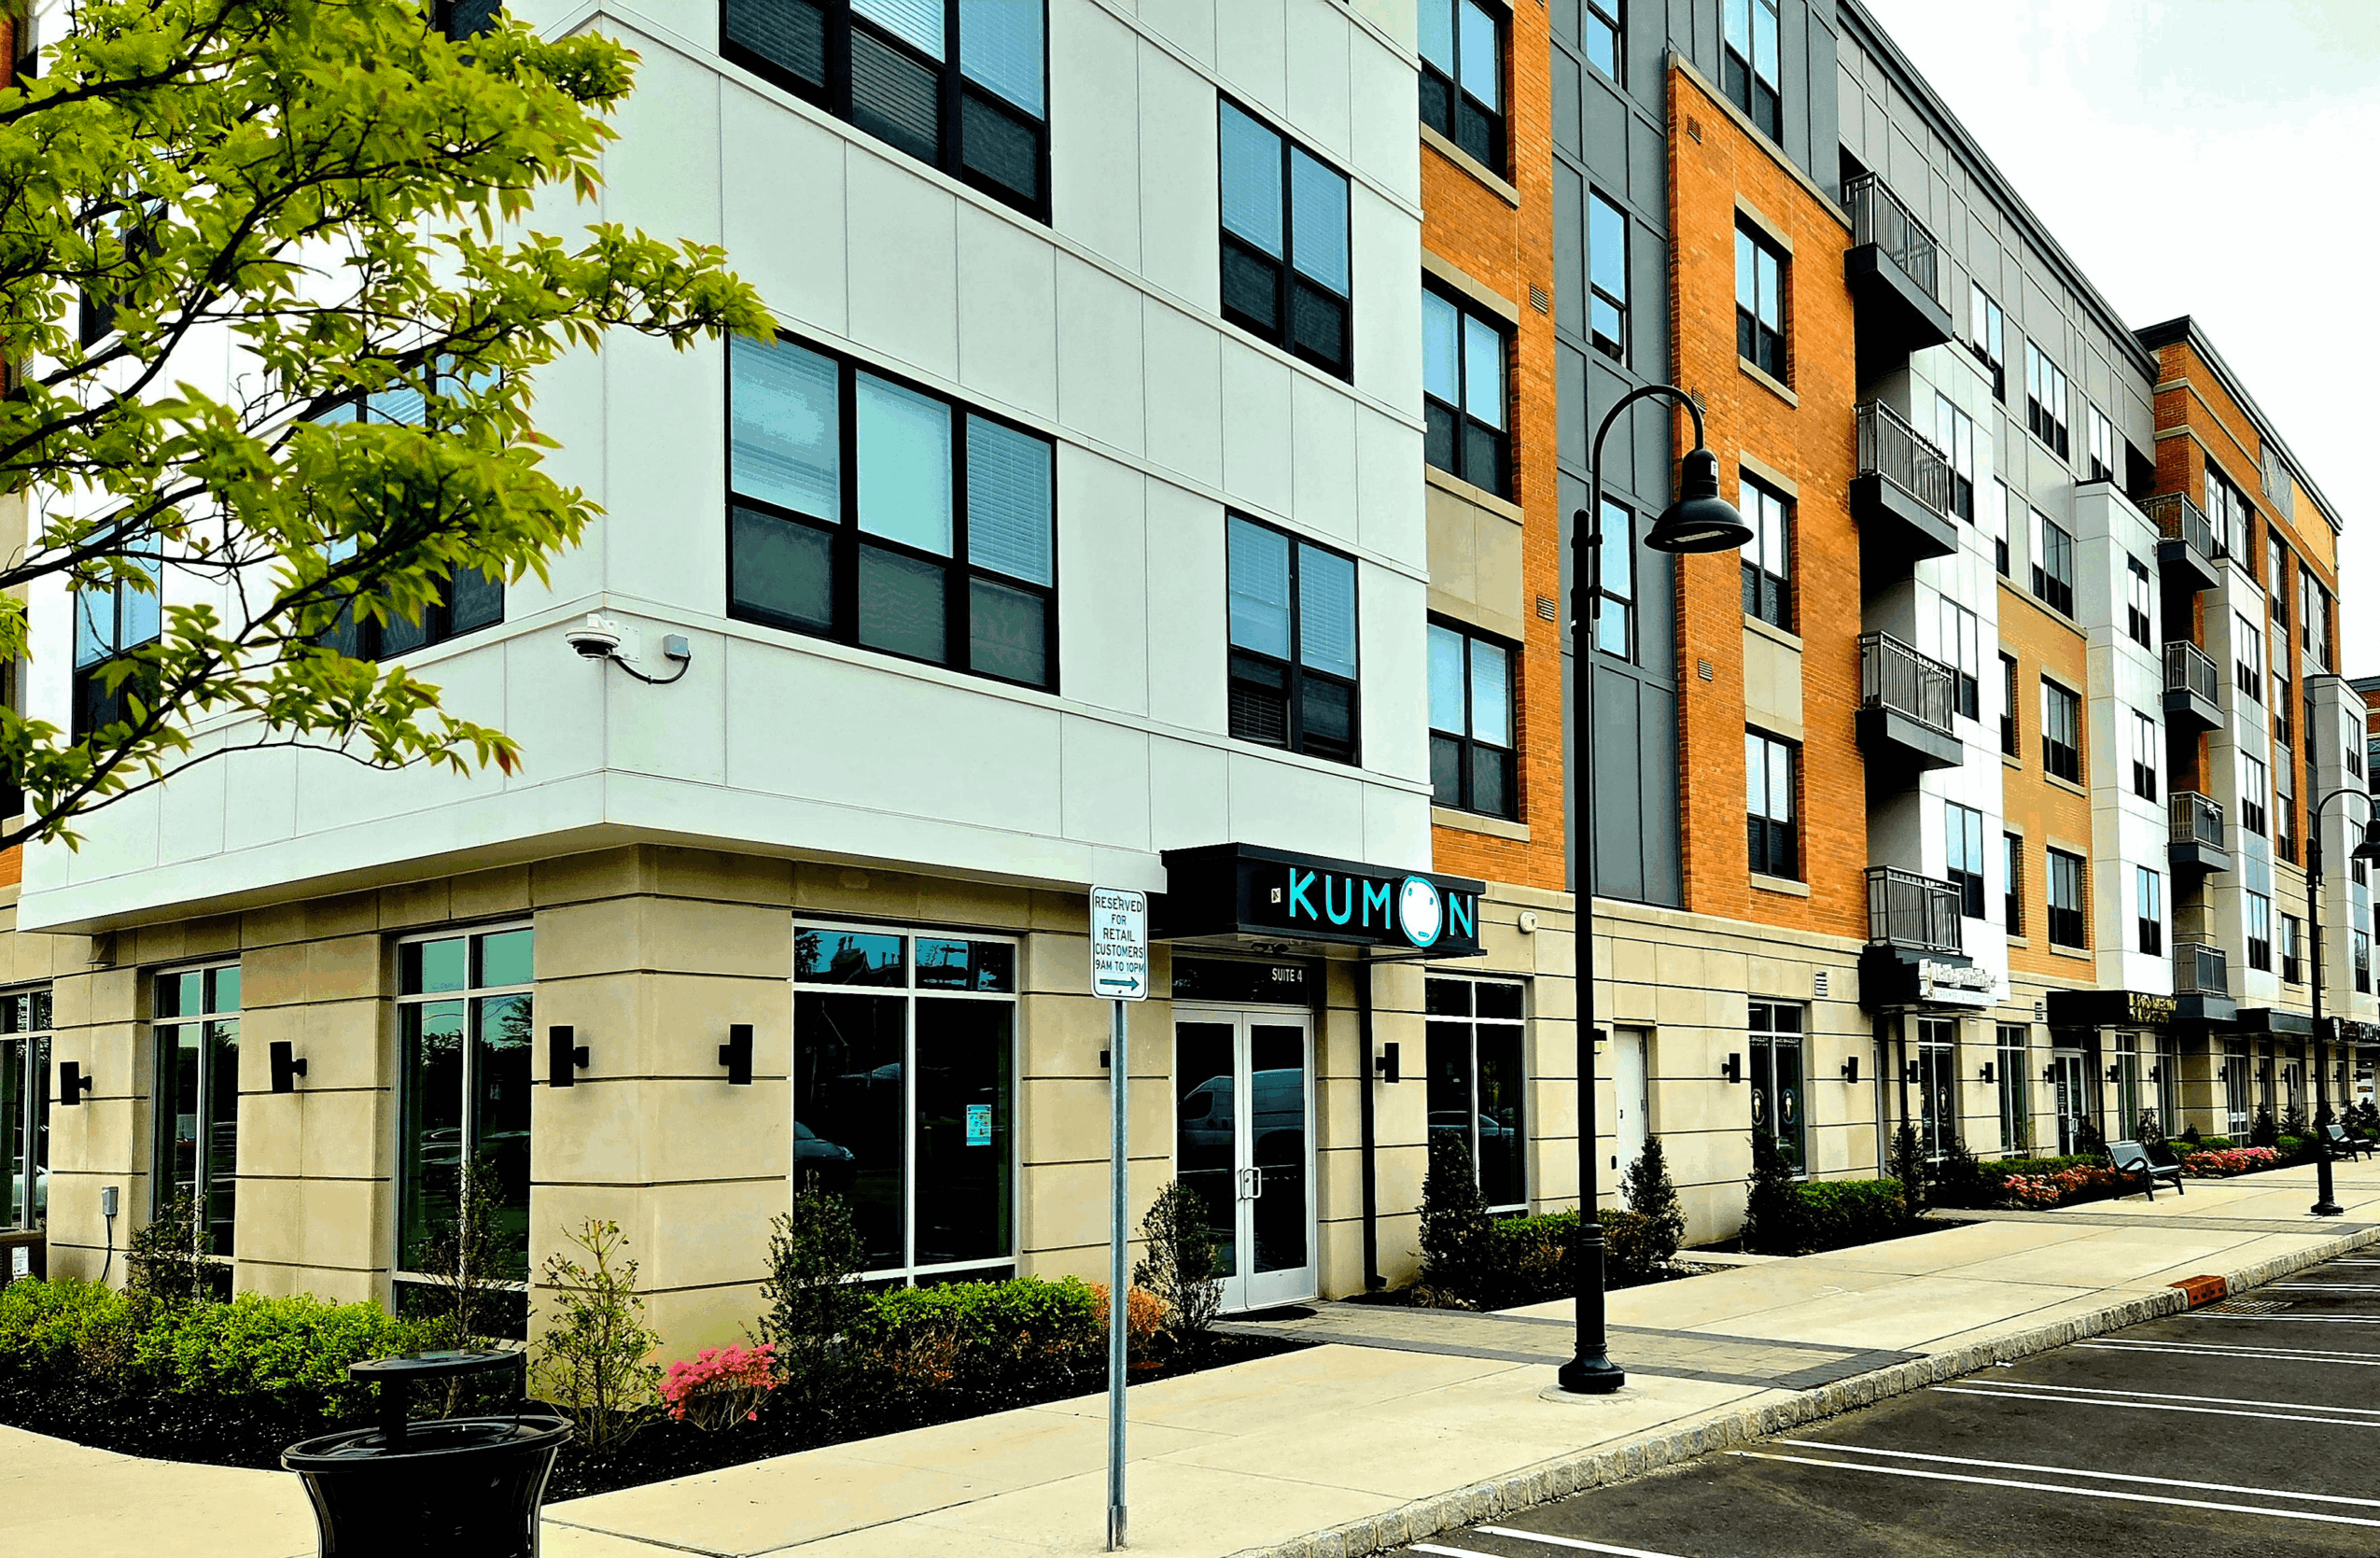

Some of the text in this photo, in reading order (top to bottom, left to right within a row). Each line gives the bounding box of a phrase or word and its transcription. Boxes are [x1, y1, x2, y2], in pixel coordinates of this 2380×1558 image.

[1095, 895, 1142, 912] RESERVED
[1289, 868, 1473, 947] KUMON
[1112, 914, 1127, 925] FOR
[1103, 927, 1135, 942] RETAIL
[1095, 943, 1143, 959] CUSTOMERS
[1096, 959, 1145, 973] 9AM TO 10PM
[1271, 967, 1303, 983] SUITE 4
